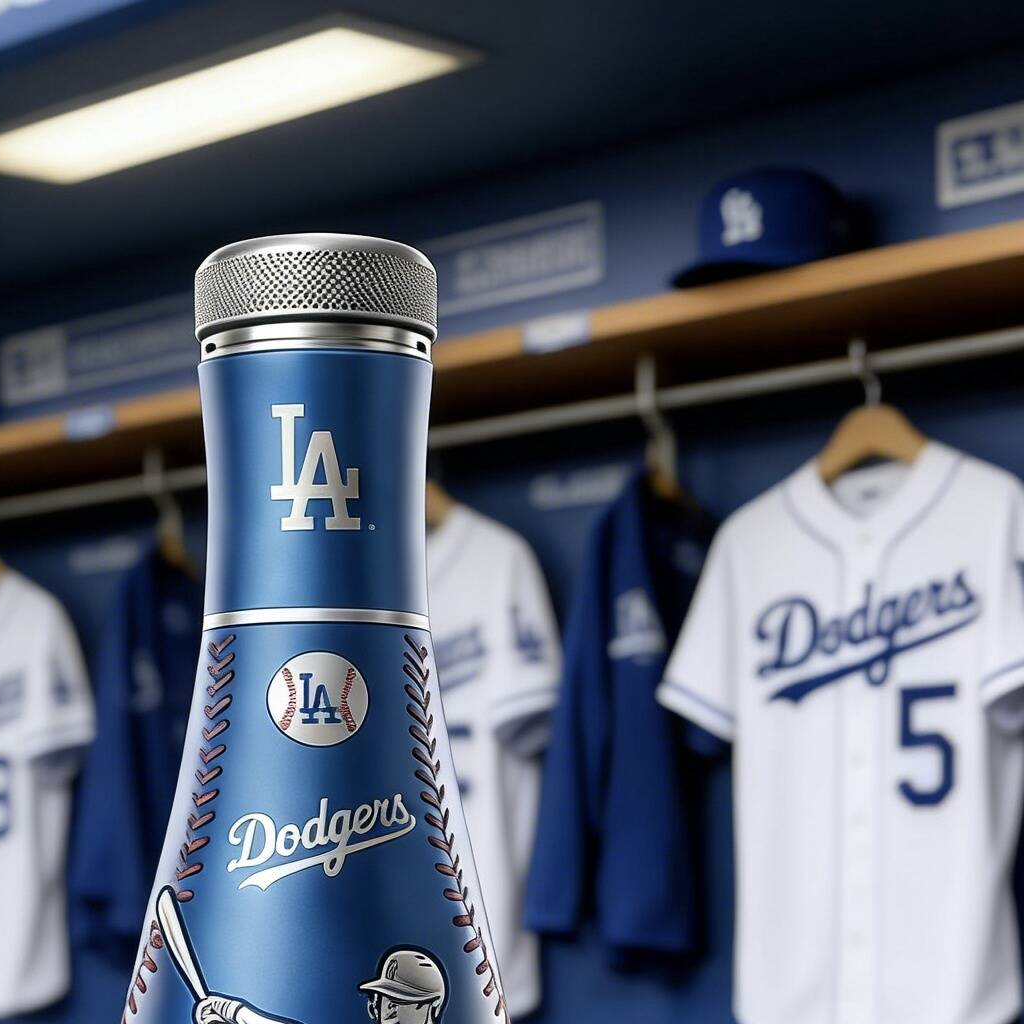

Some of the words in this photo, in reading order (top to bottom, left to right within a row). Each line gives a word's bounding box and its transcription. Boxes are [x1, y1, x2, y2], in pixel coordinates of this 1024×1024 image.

[270, 403, 361, 531] LA
[298, 672, 341, 724] LA
[752, 568, 984, 706] Dodgers
[896, 683, 959, 809] 5
[226, 793, 417, 892] Dodgers
